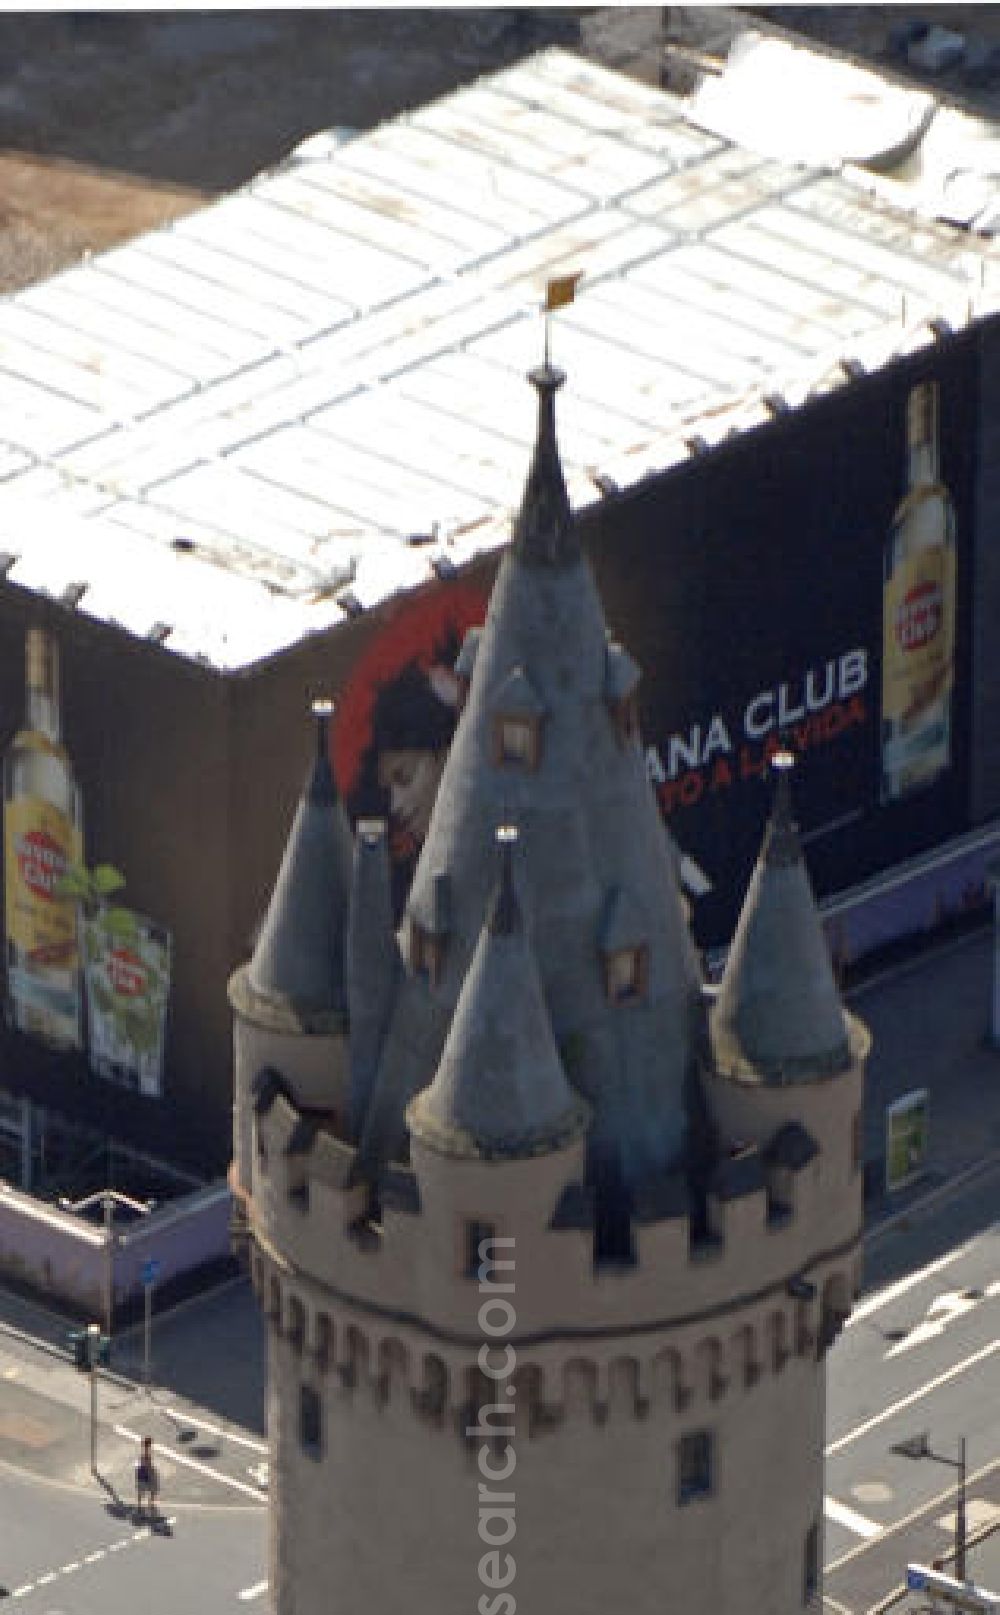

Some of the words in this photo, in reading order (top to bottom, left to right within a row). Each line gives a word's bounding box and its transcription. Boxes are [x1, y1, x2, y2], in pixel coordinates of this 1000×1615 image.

[646, 713, 732, 783] ANA
[744, 648, 868, 736] CLUB
[655, 771, 703, 815] TO
[711, 757, 731, 790] A
[793, 694, 866, 751] VIDA
